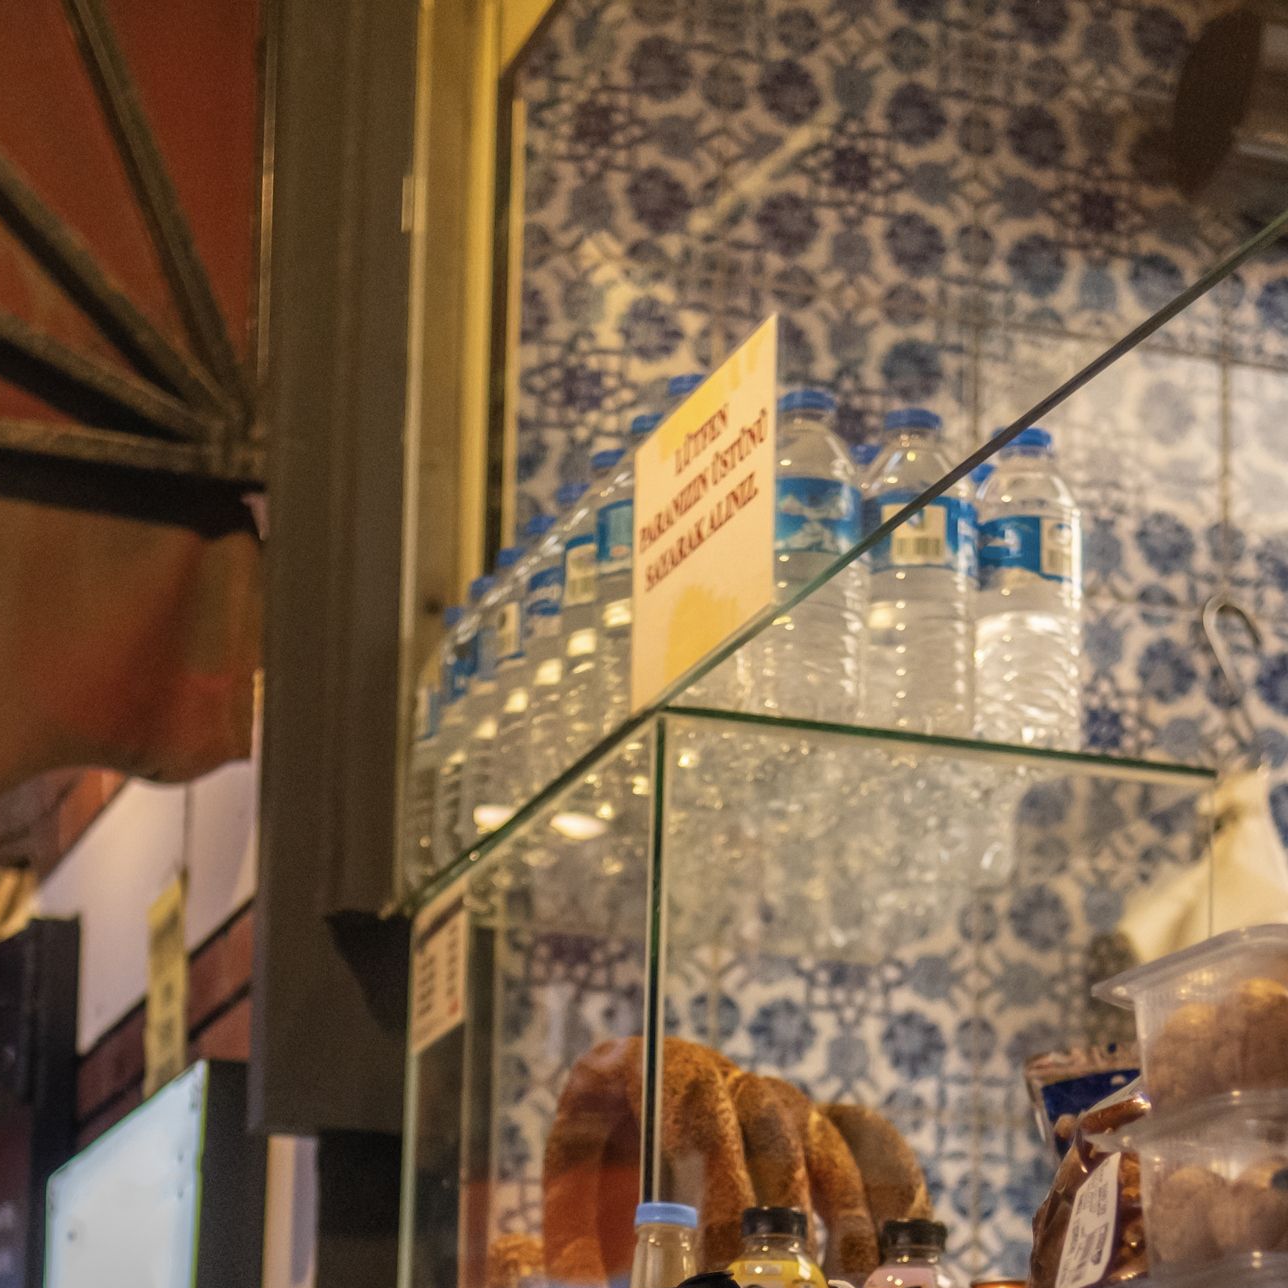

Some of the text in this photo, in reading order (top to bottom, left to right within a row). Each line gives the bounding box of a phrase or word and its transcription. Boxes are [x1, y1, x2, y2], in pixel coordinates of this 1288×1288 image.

[674, 403, 729, 474] LÜTFEN
[639, 408, 768, 554] PARANIZIN ÜSTÜNÜ
[644, 516, 706, 592] SAYARAK
